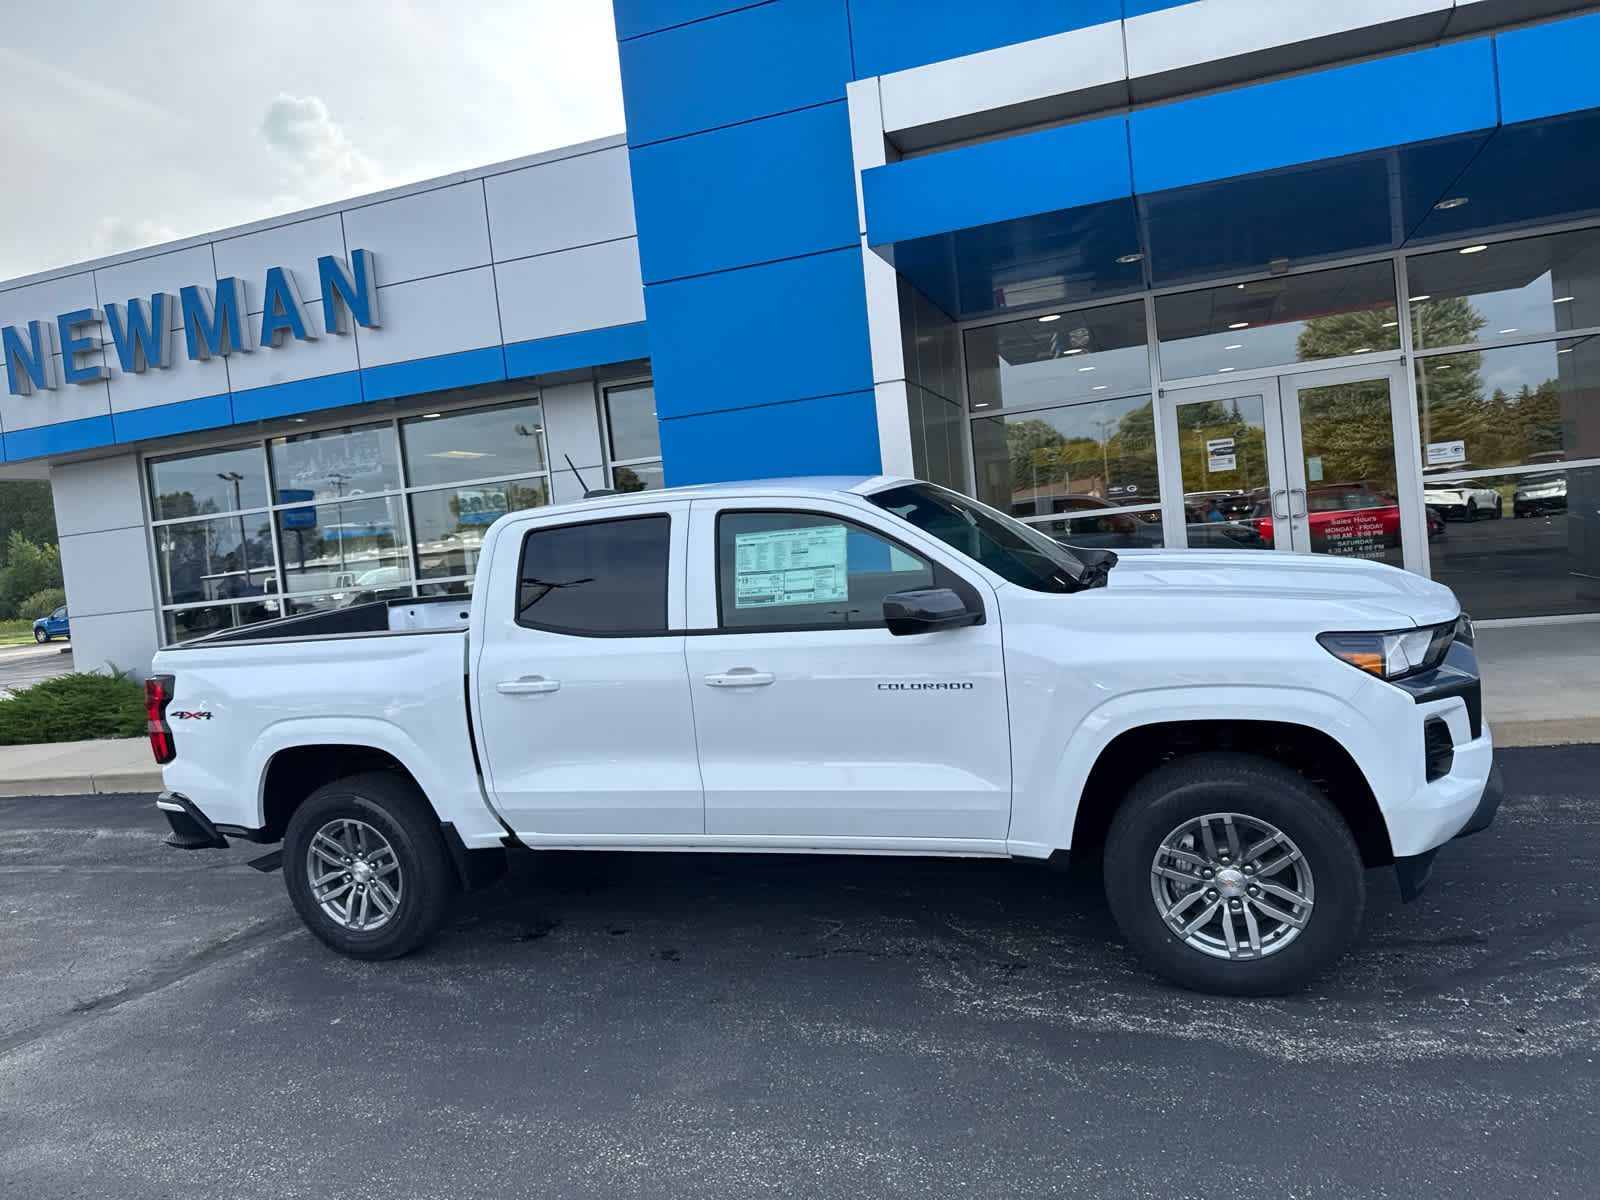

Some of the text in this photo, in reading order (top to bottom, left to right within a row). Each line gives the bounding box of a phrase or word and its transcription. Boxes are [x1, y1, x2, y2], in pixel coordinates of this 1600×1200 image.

[1, 248, 378, 396] NEWMAN
[1331, 517, 1352, 525] Sales
[877, 682, 974, 690] COLORADO
